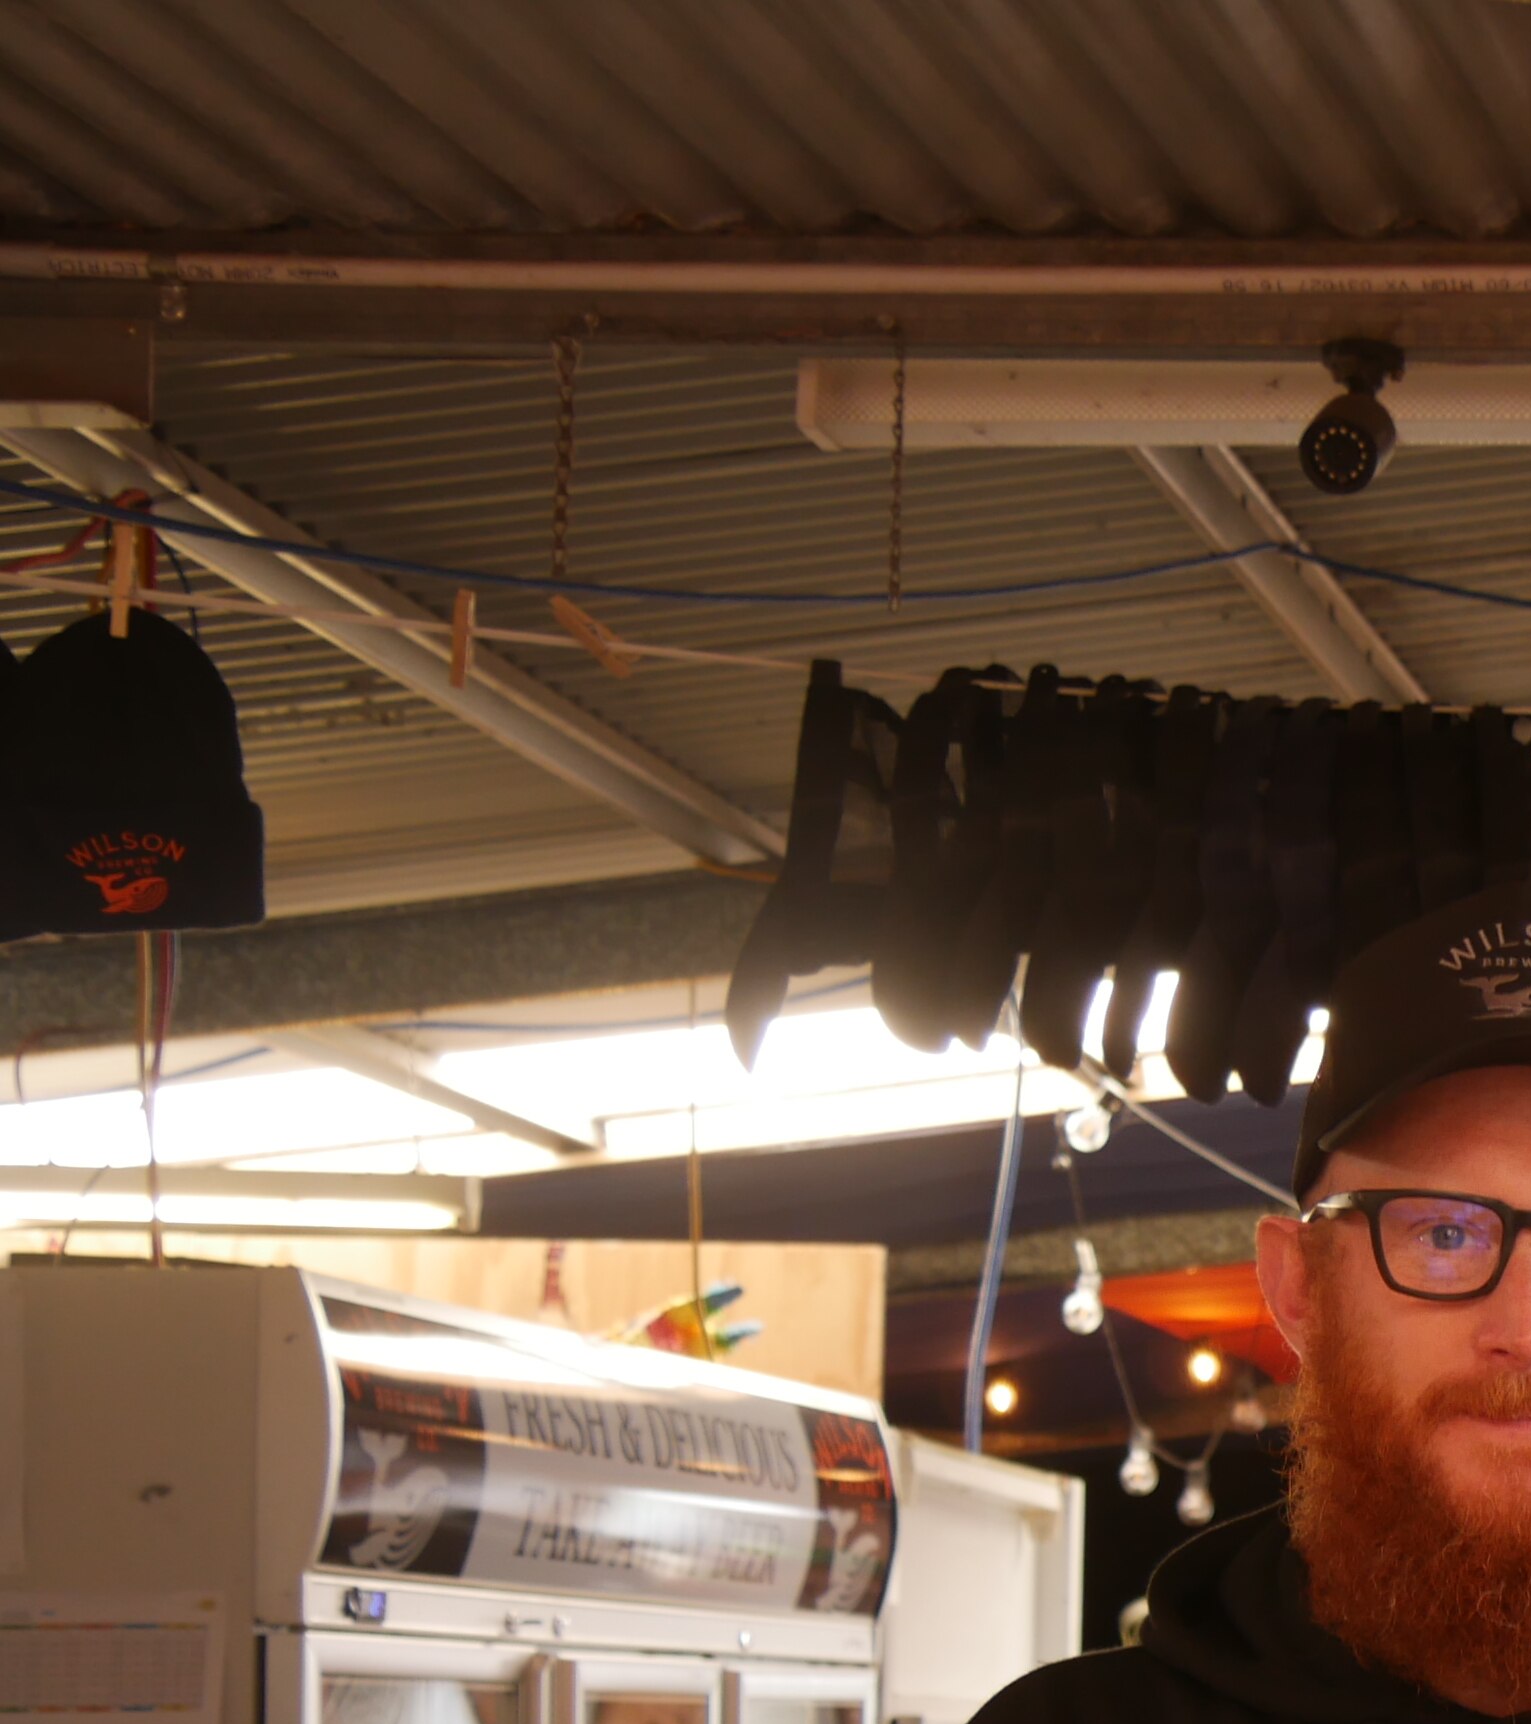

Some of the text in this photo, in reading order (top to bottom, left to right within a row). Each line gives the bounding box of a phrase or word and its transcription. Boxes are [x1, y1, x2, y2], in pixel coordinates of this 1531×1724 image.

[65, 831, 189, 870] WILSON
[502, 1390, 611, 1461] FRESH
[653, 1413, 798, 1494] DELICIOUS
